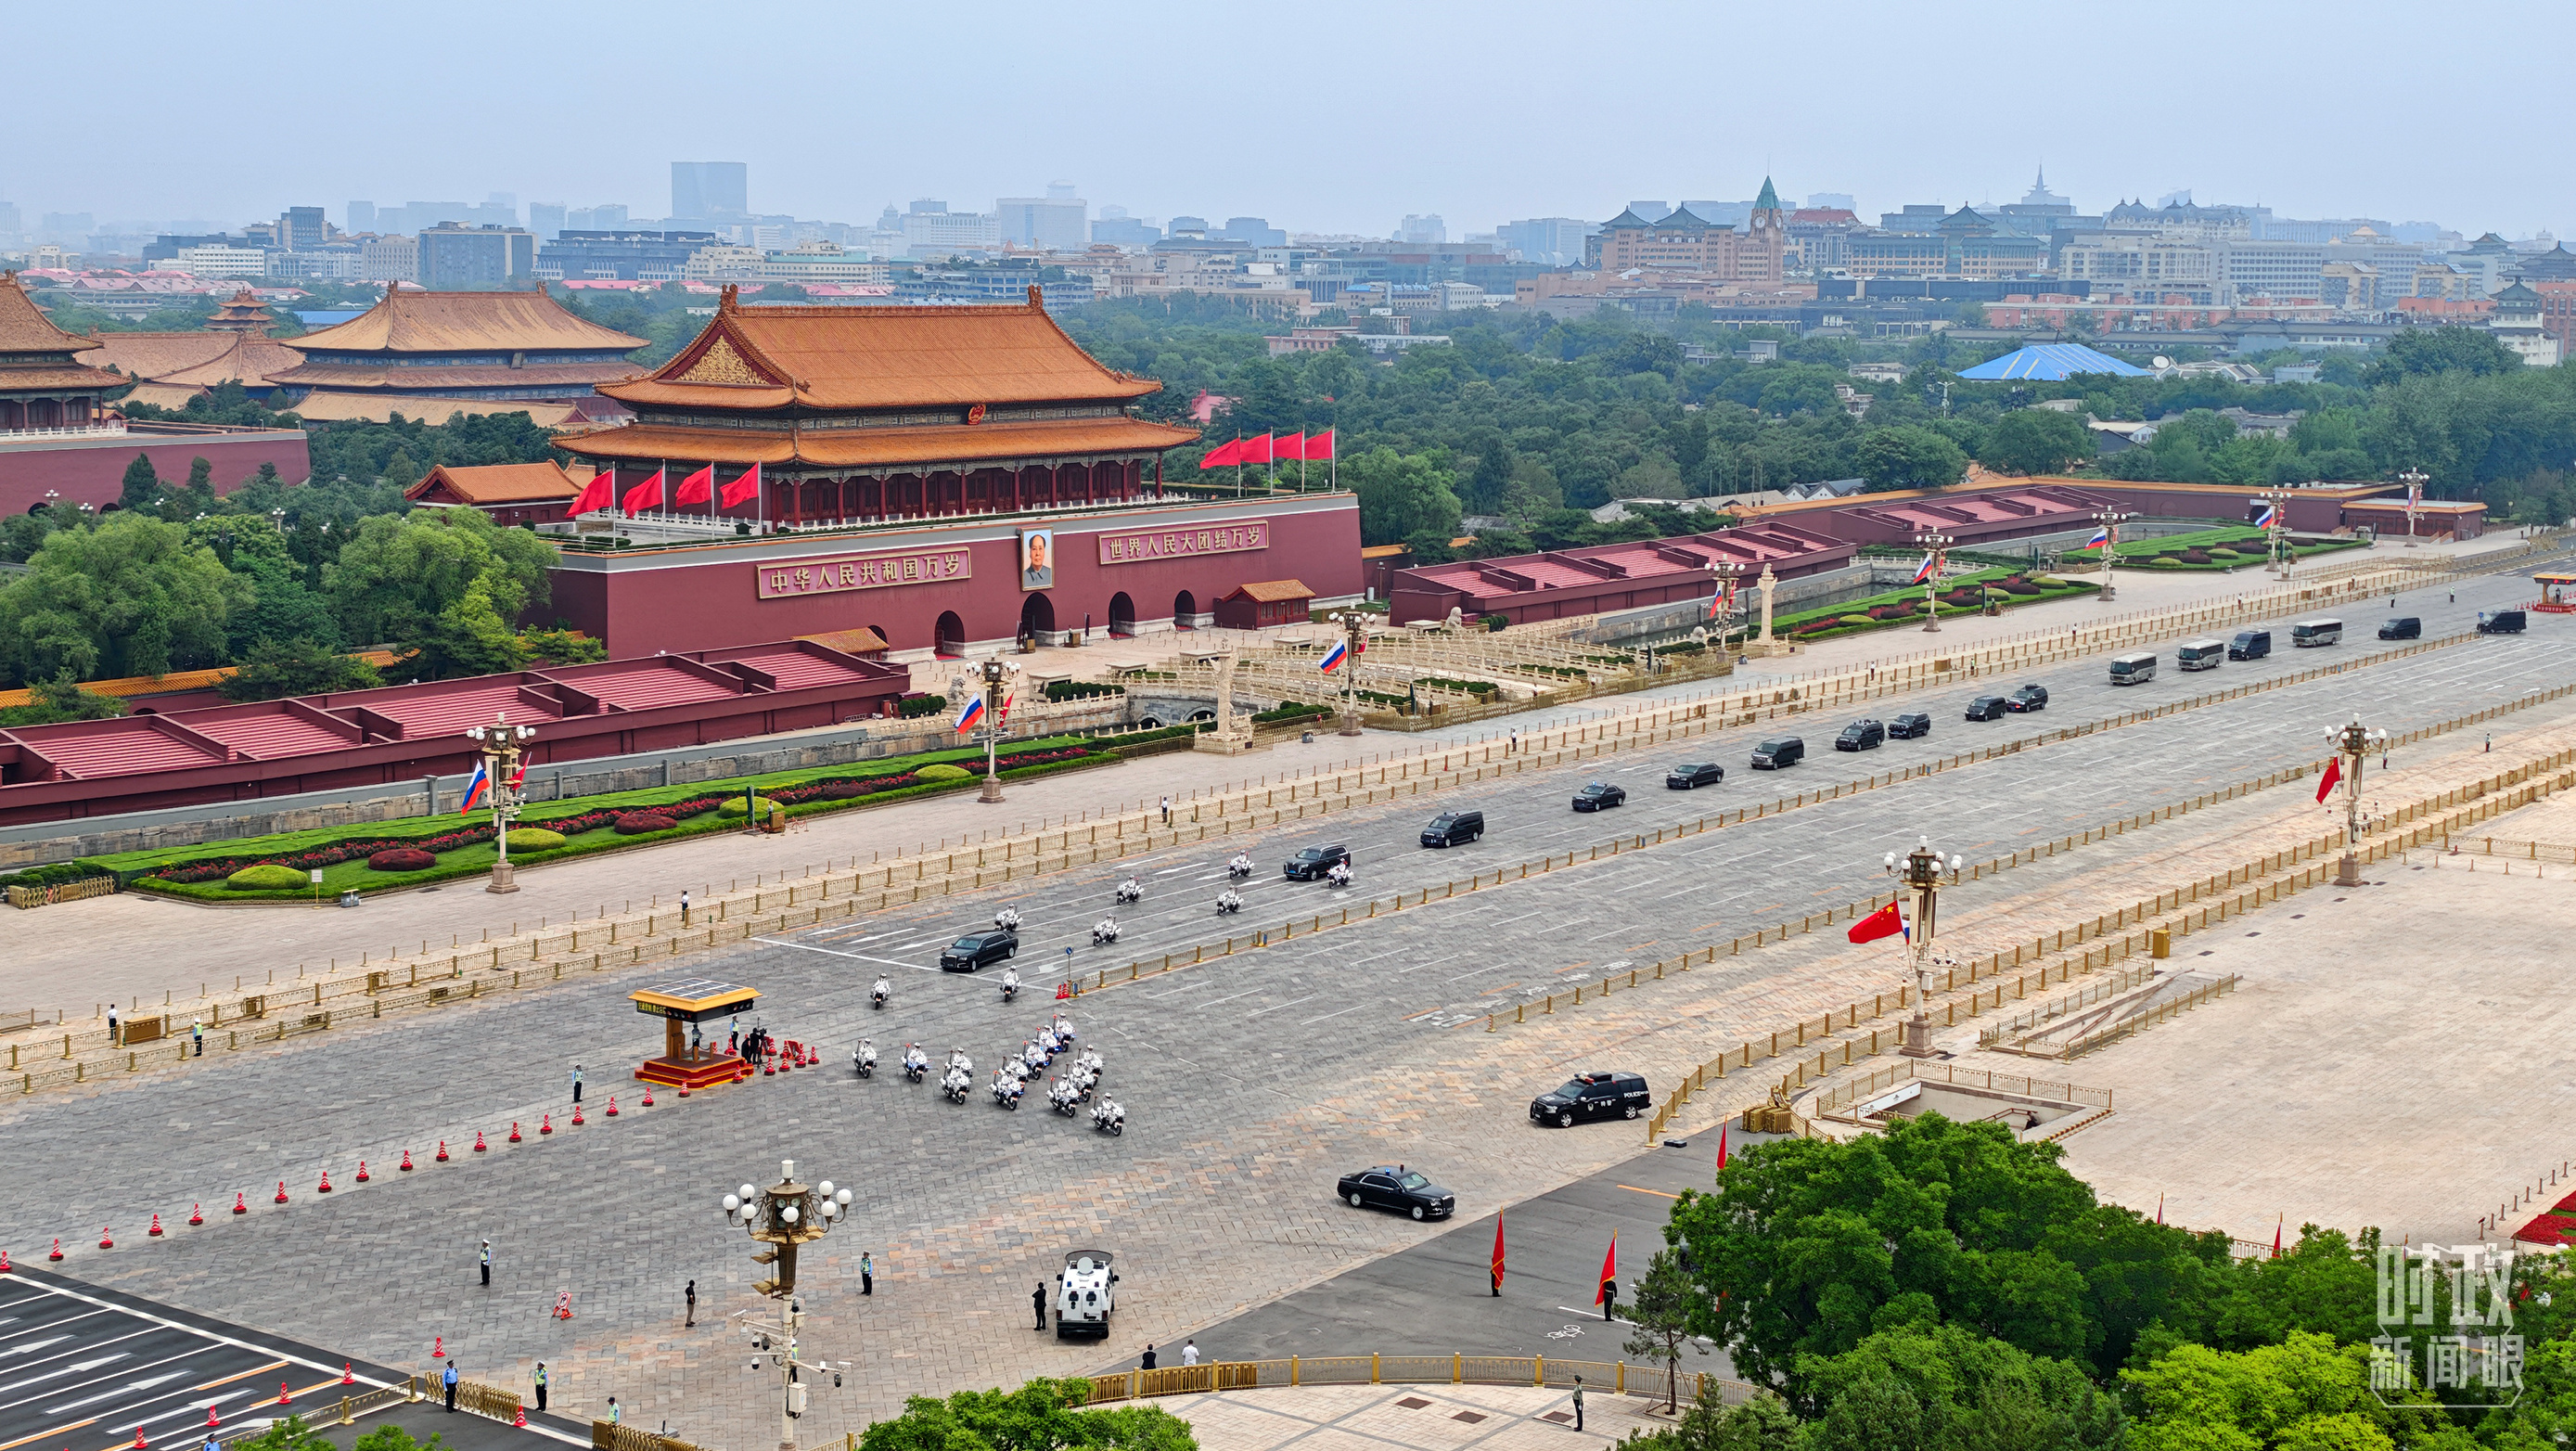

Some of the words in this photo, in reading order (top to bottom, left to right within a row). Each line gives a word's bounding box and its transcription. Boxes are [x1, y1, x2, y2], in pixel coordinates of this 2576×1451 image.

[1109, 527, 1261, 559] 世界人民大团结万岁
[771, 554, 960, 593] 中华人民共和国万岁
